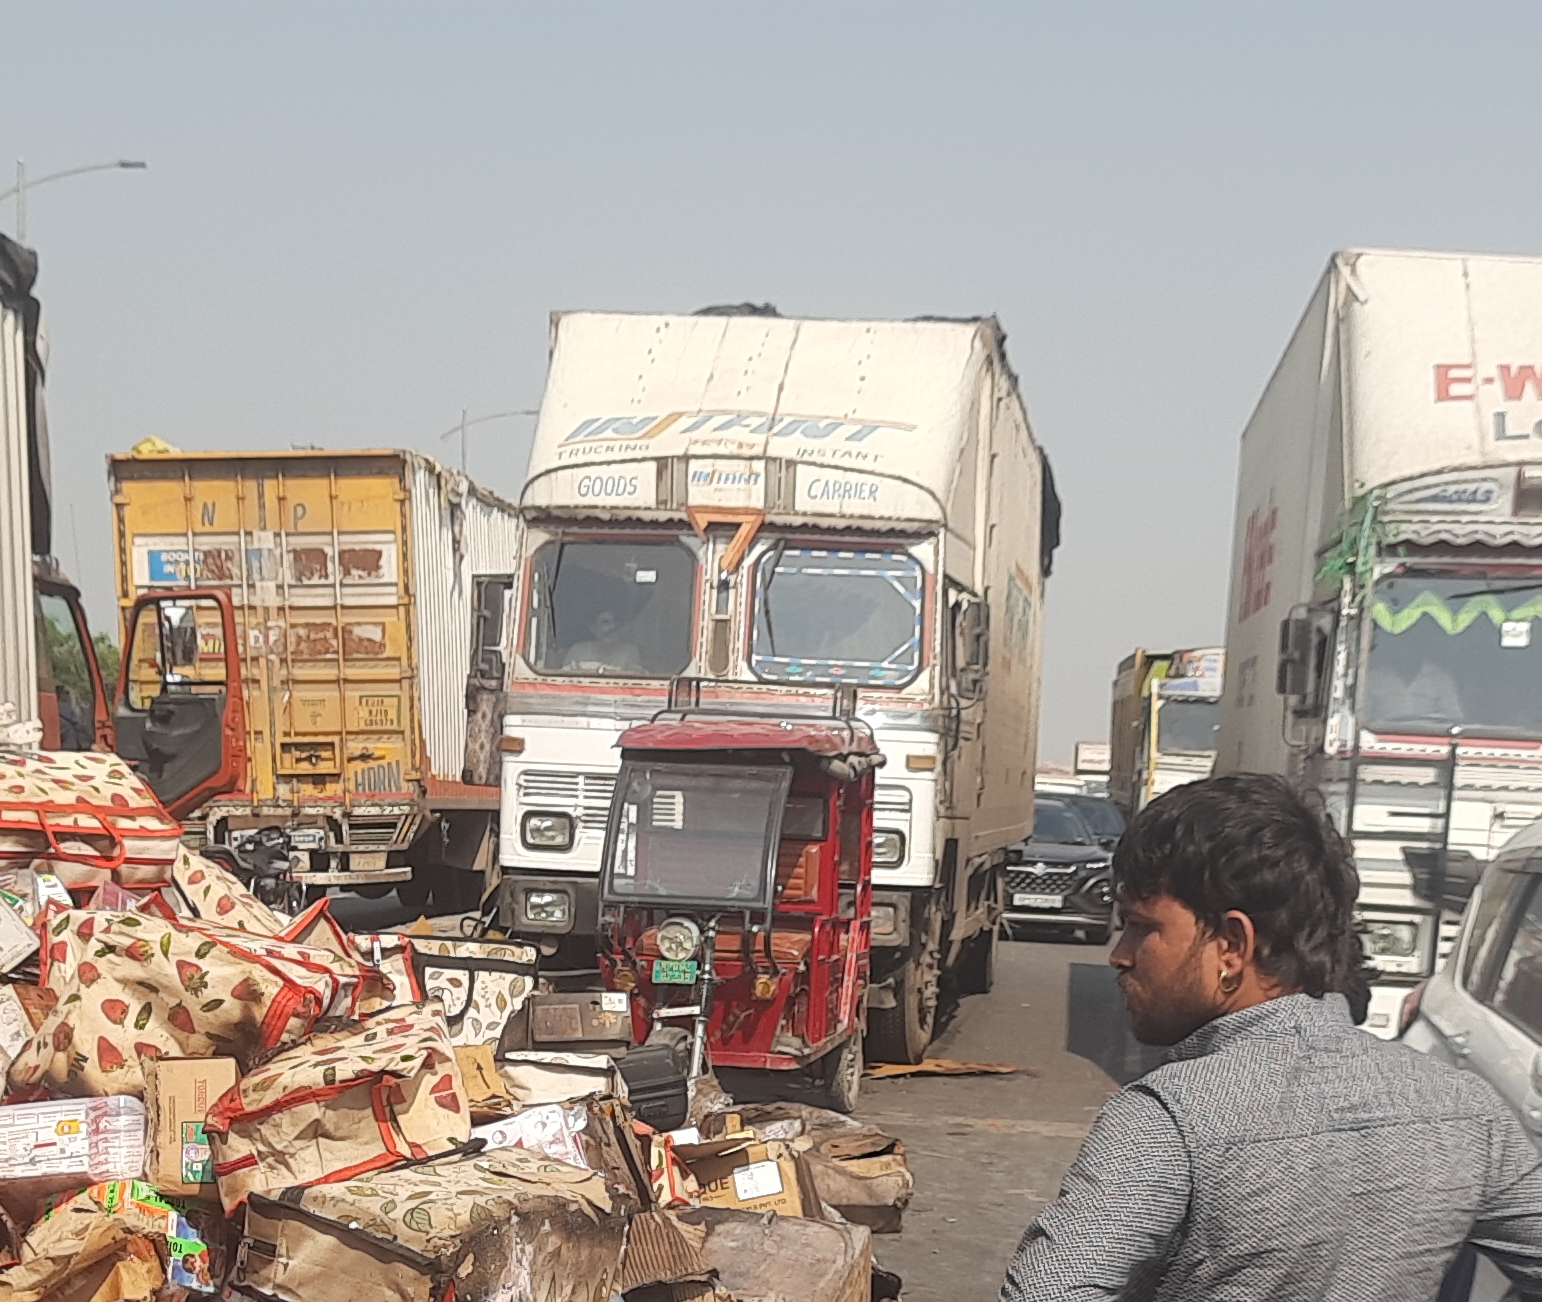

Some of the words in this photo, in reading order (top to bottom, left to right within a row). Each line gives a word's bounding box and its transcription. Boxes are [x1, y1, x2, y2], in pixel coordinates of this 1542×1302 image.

[577, 475, 639, 497] GOODS
[807, 478, 880, 503] CARRIER
[201, 501, 217, 527] N
[293, 502, 307, 531] P
[353, 759, 402, 793] HORN
